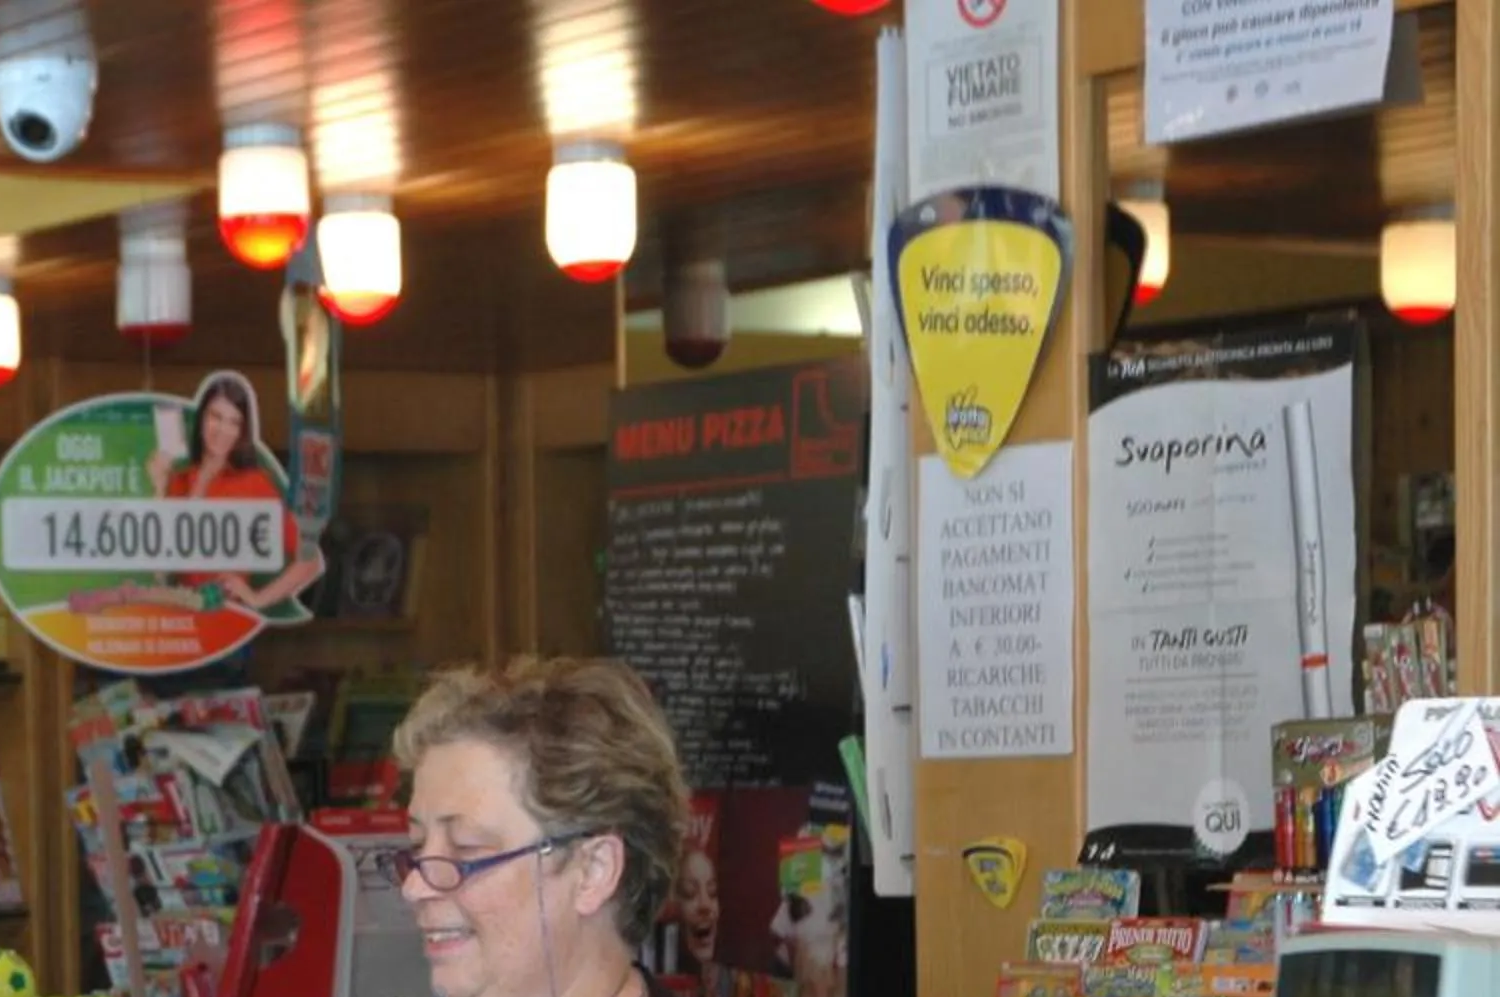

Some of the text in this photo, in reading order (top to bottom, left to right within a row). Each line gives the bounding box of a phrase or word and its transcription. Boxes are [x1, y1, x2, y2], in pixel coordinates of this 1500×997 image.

[946, 52, 1021, 84] VIETATO
[947, 77, 1021, 107] FUMARE
[922, 266, 1040, 298] Vinci spesso,
[918, 304, 1035, 335] vinci adesso.
[611, 403, 786, 461] MENU PIZZA
[1114, 423, 1267, 475] Svaporina
[44, 463, 124, 493] JACKPOT
[1009, 480, 1025, 503] SI
[41, 510, 272, 559] 14.600.000 €
[940, 509, 1053, 539] ACCETTANO
[940, 540, 1051, 568] PAGAMENTI
[942, 572, 1048, 600] BANCOMAT
[949, 602, 1042, 628] INFERIORI
[949, 638, 962, 658] A
[1149, 626, 1199, 651] TANTI
[1202, 624, 1249, 647] GUSTI
[946, 663, 1046, 688] RICARICHE
[951, 693, 1044, 718] TABACCHI
[938, 723, 1056, 749] IN CONTANTI
[1205, 809, 1242, 832] QUI
